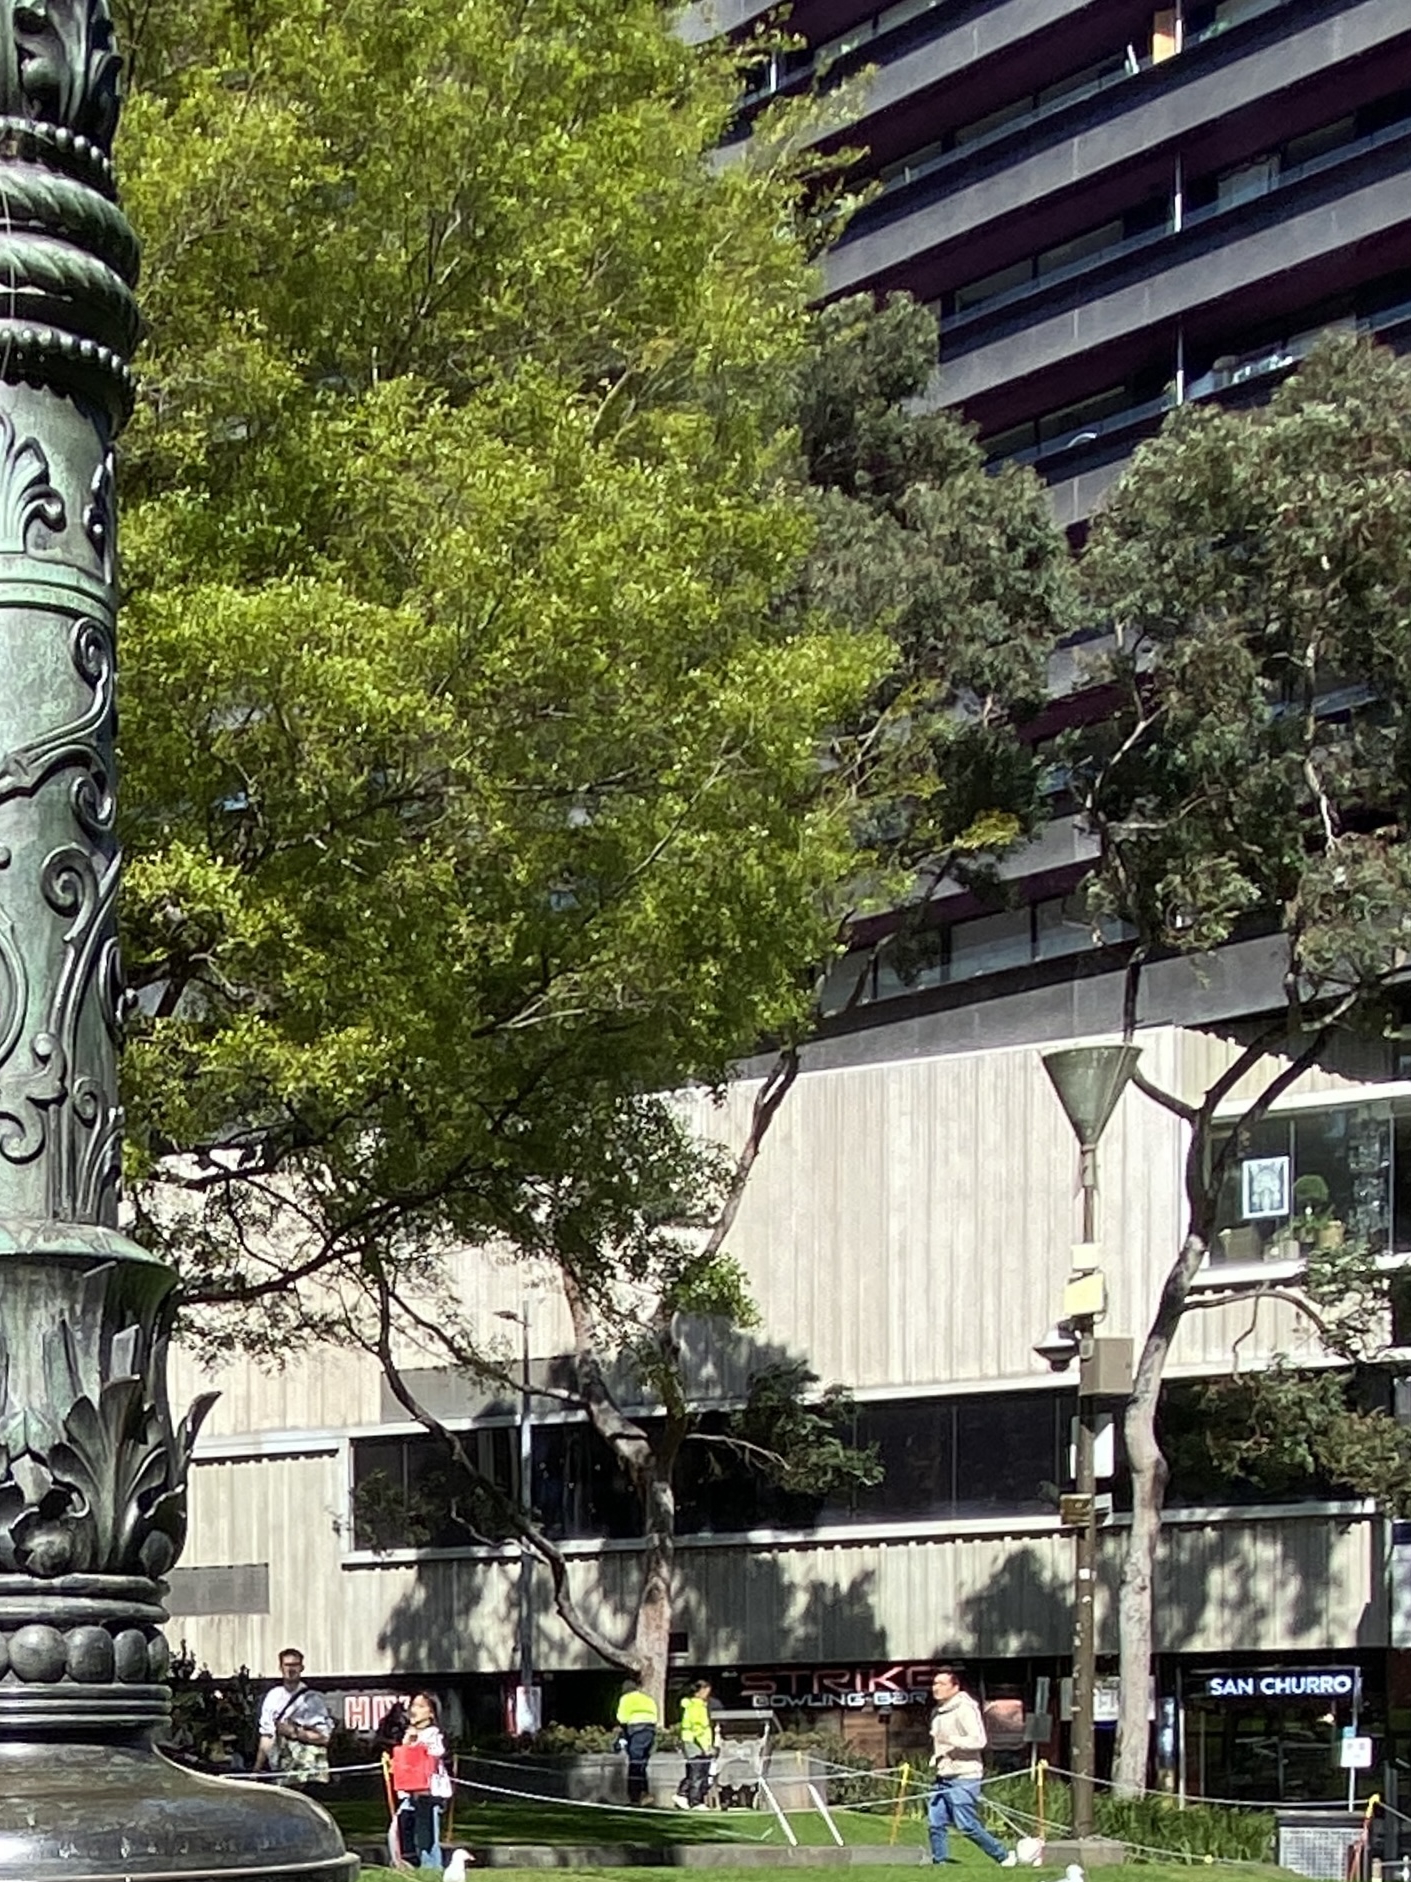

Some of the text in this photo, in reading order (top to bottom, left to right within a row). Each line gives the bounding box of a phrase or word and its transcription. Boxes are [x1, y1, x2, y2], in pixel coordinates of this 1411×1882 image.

[741, 1666, 934, 1696] STRIKE
[1210, 1675, 1352, 1695] SAN CHURRO
